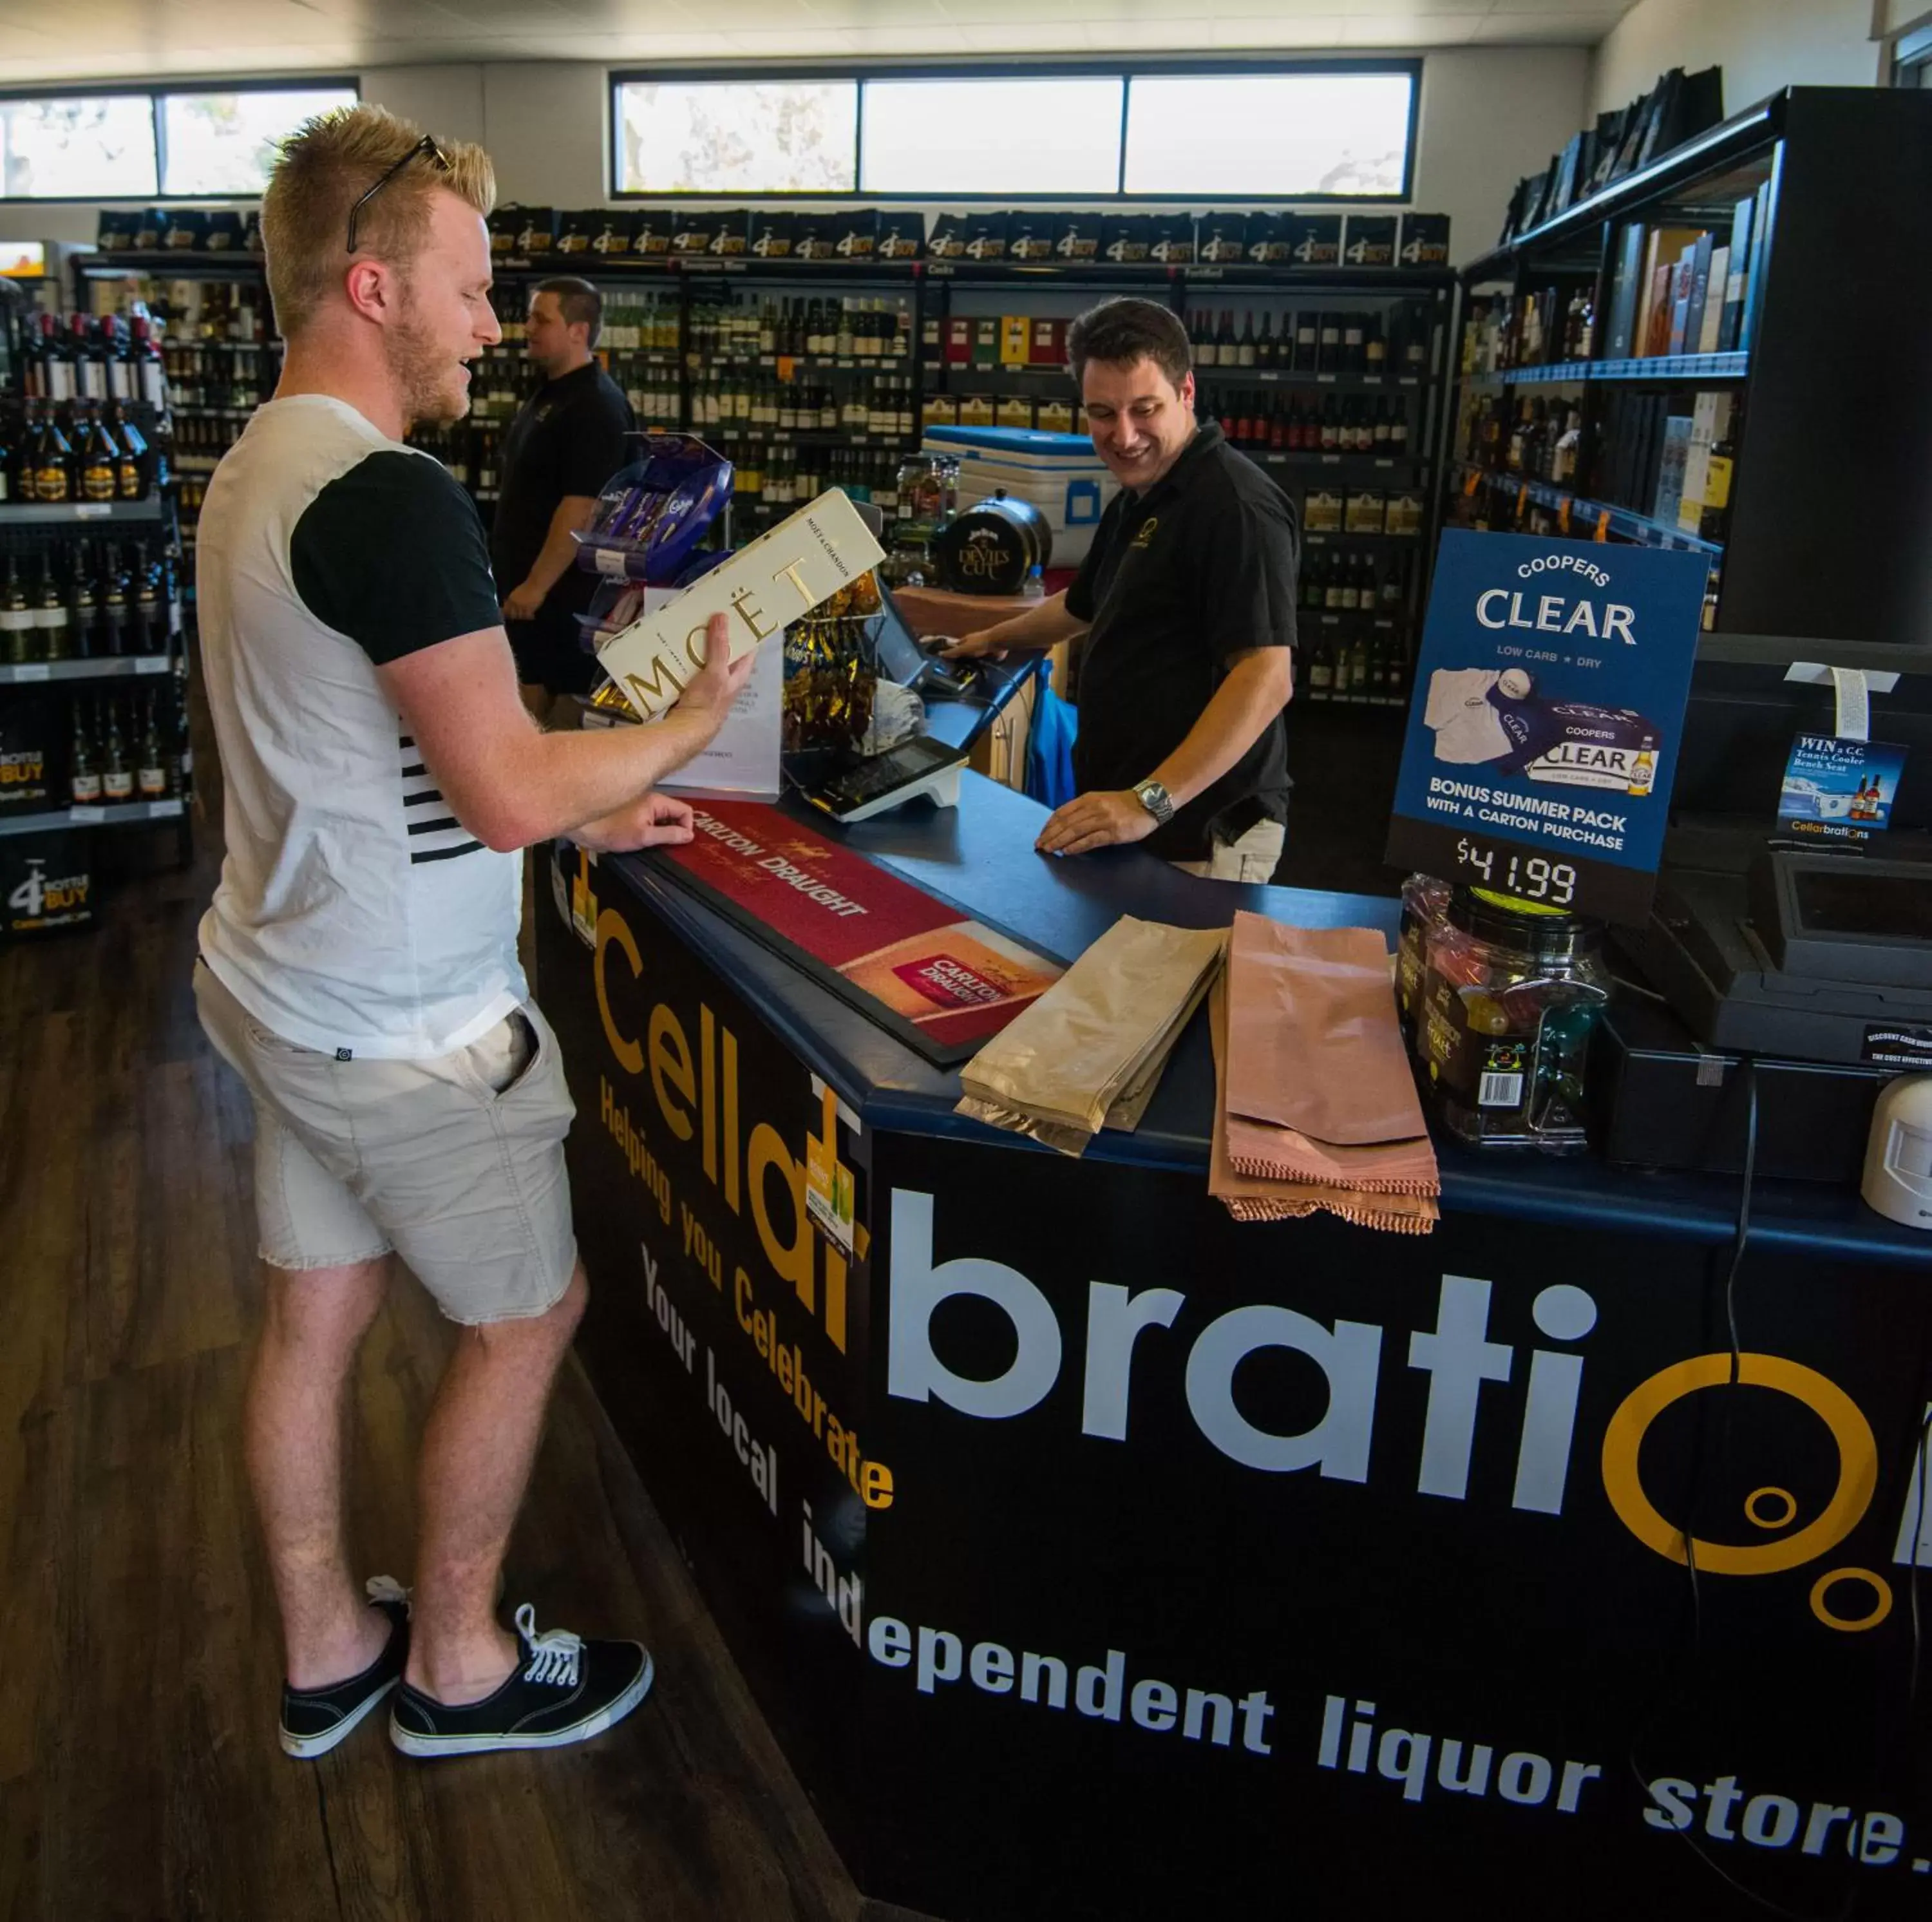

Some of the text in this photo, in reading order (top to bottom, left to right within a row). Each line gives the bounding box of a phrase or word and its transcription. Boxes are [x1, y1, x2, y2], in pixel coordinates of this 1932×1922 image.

[1517, 555, 1610, 587] COOPERS
[1475, 589, 1638, 645] CLEAR
[1497, 645, 1602, 669] LOW CARB DRY
[1566, 726, 1616, 741] COOPERS
[1799, 737, 1837, 752] WIN
[1546, 745, 1626, 771] CLEAR
[1793, 758, 1824, 770] Bench
[1825, 763, 1847, 773] Seat
[1795, 749, 1864, 765] Tennis Cooler
[1426, 796, 1624, 852] WITH A CARTON PURCHASE
[1429, 776, 1627, 833] BONUS SUMMER PACK
[692, 811, 764, 856] CARLTON
[757, 855, 869, 917] DRAUGHT
[1457, 837, 1577, 904] $41.99
[8, 867, 46, 915] 4
[44, 883, 88, 910] BUY
[920, 967, 986, 1005] DRAUGHT
[932, 958, 1005, 1004] CARLTON
[600, 1075, 671, 1225] Helping
[681, 1202, 723, 1291] you
[735, 1266, 894, 1509] Celebrate
[641, 1242, 696, 1375] Your
[708, 1346, 777, 1517] local
[1318, 1695, 1602, 1813] liquor
[1643, 1776, 1931, 1874] store.
